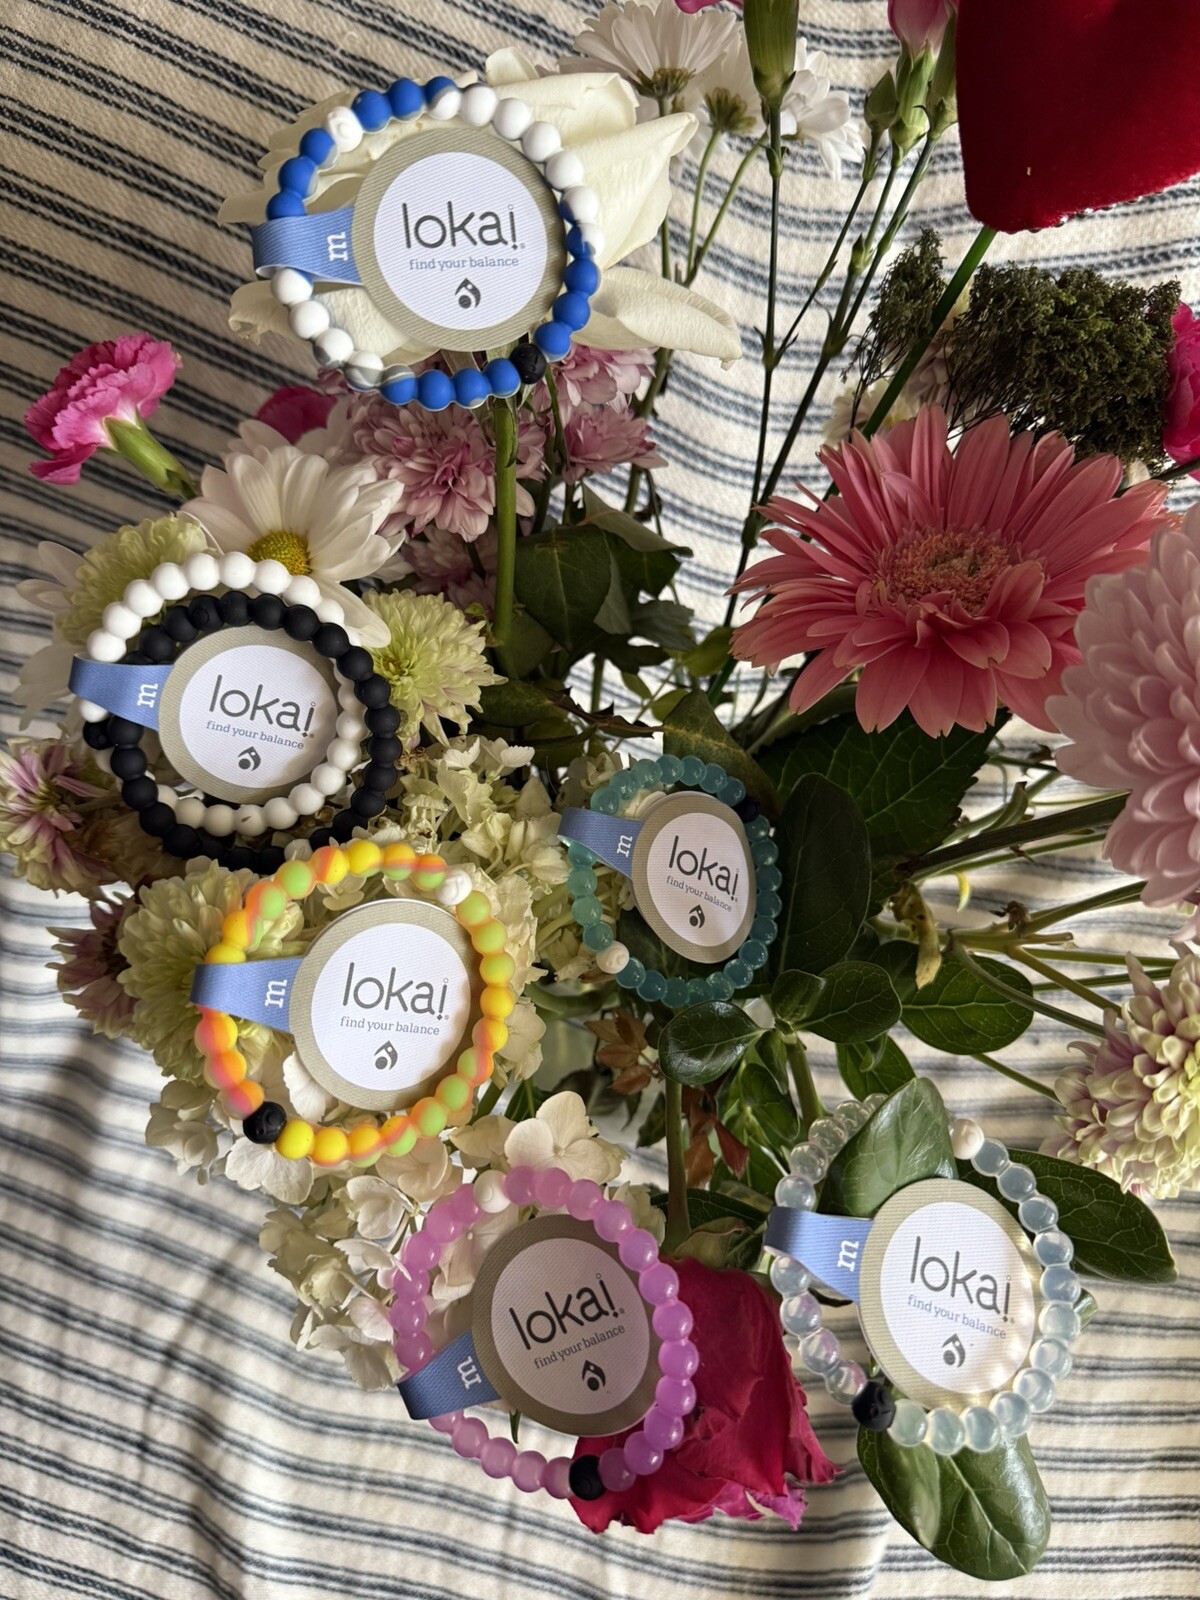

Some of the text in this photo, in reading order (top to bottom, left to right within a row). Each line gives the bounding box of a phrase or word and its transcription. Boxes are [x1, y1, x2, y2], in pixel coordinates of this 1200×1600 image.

[409, 257, 519, 271] find your balance
[206, 720, 304, 749] find your balance
[666, 875, 732, 912] find your balance
[340, 1016, 439, 1035] find your balance
[908, 1294, 1006, 1339] find your balance
[534, 1324, 625, 1369] find your balance
